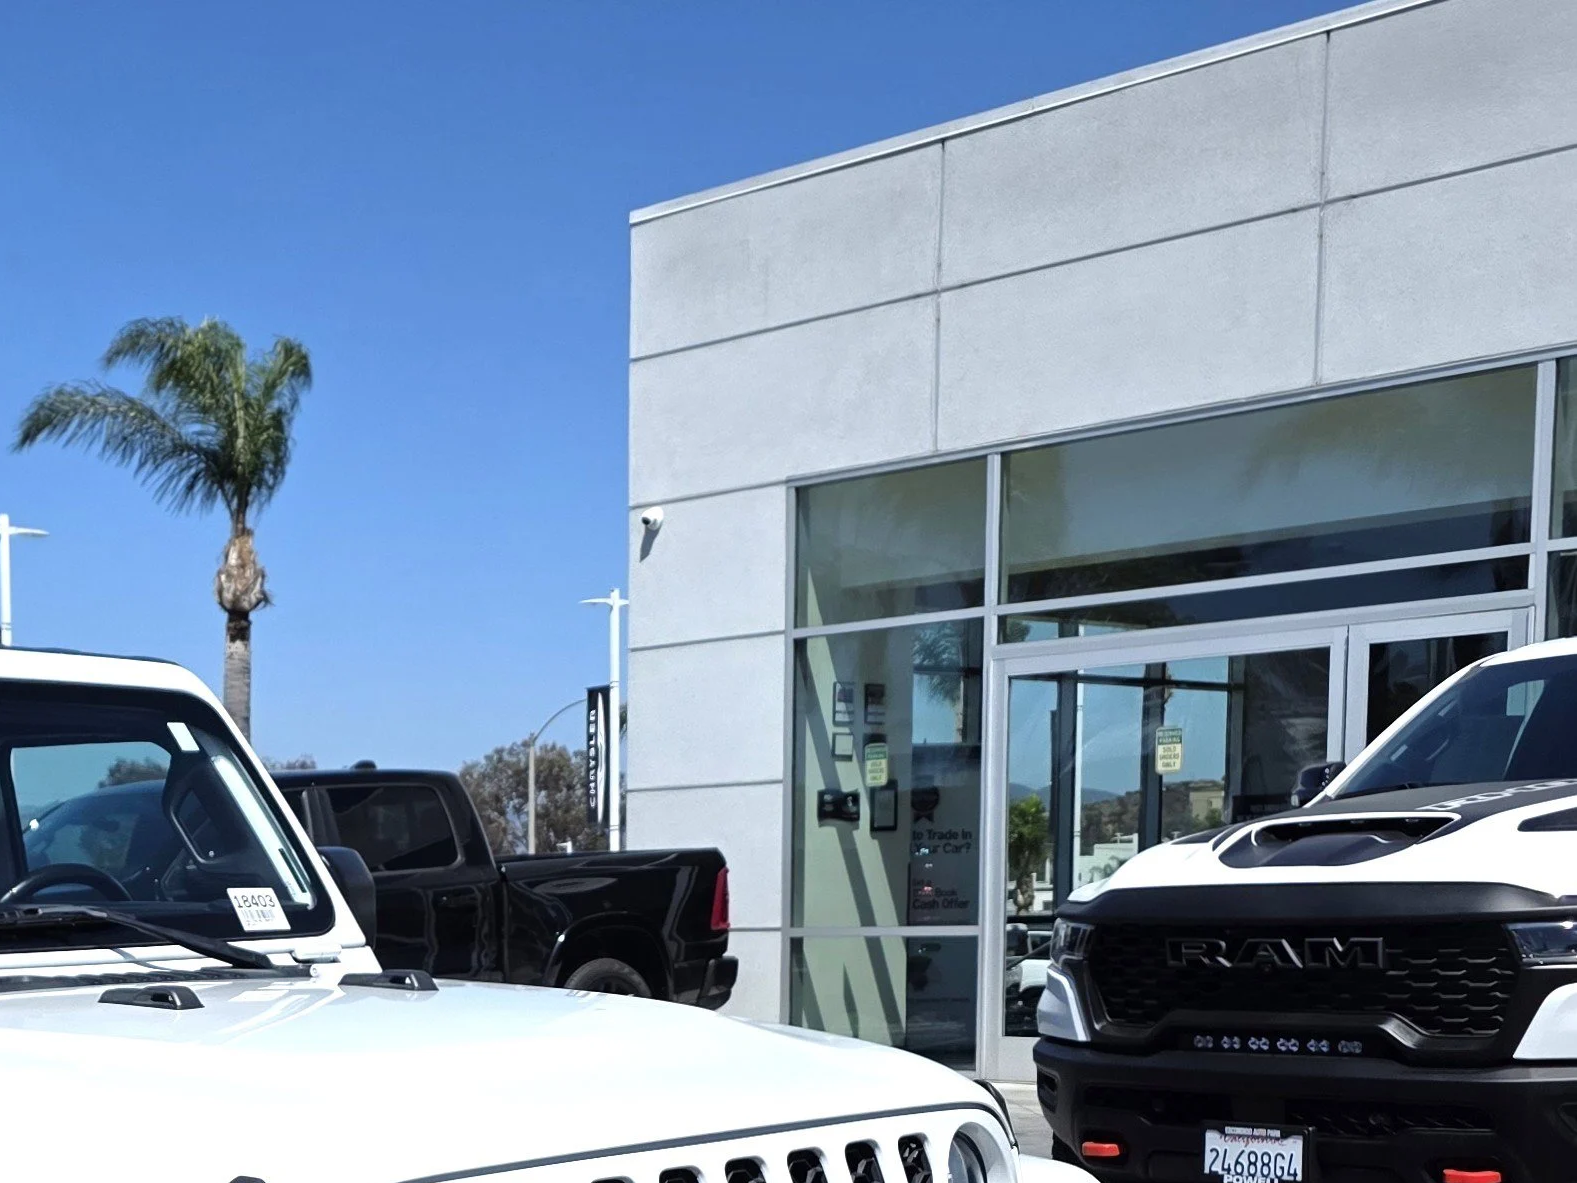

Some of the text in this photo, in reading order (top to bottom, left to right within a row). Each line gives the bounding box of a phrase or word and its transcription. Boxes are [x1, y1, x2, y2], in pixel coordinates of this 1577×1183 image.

[926, 828, 960, 840] Trade
[943, 842, 973, 854] Car?
[234, 895, 276, 908] 18403
[942, 898, 971, 909] Offer
[1167, 937, 1383, 968] RAM
[1209, 1147, 1298, 1180] 24688G4
